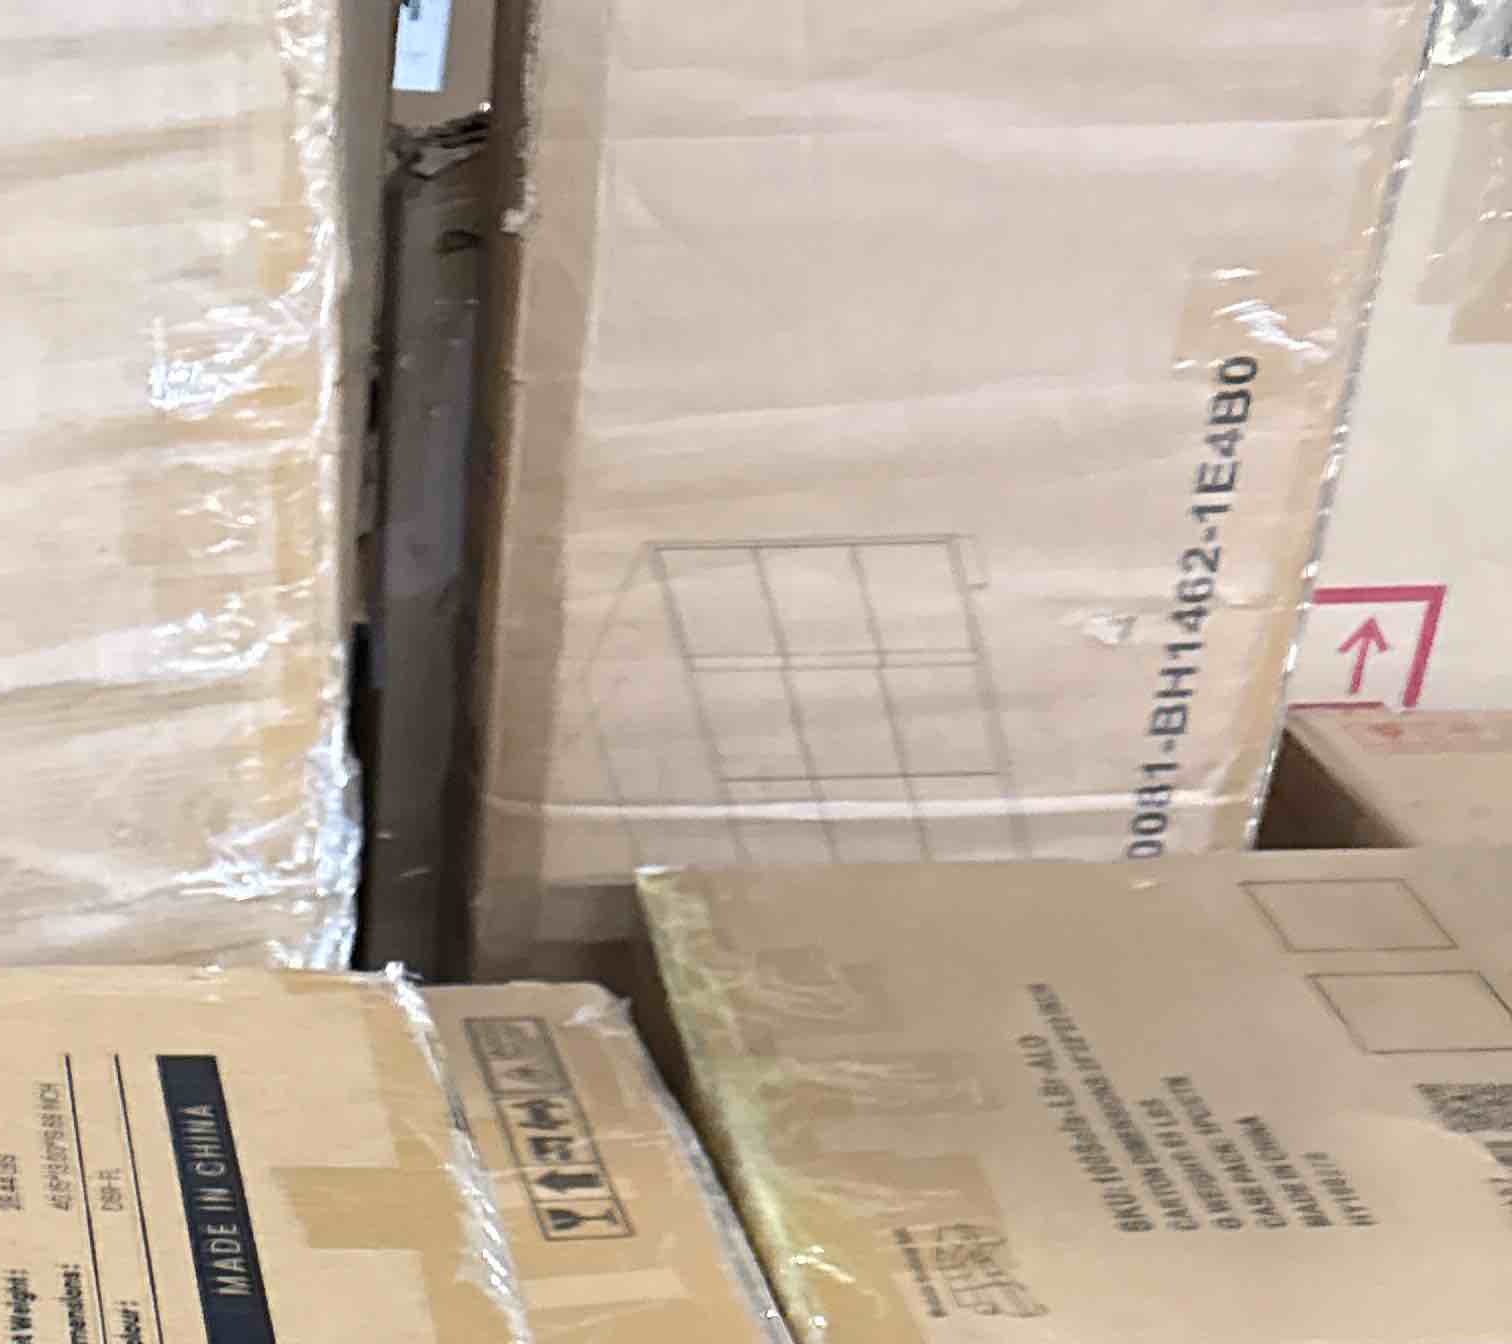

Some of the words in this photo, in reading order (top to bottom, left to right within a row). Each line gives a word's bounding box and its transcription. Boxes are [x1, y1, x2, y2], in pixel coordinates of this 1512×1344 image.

[178, 1103, 226, 1177] CHINA
[195, 1187, 235, 1212] IN
[205, 1223, 254, 1296] MADE
